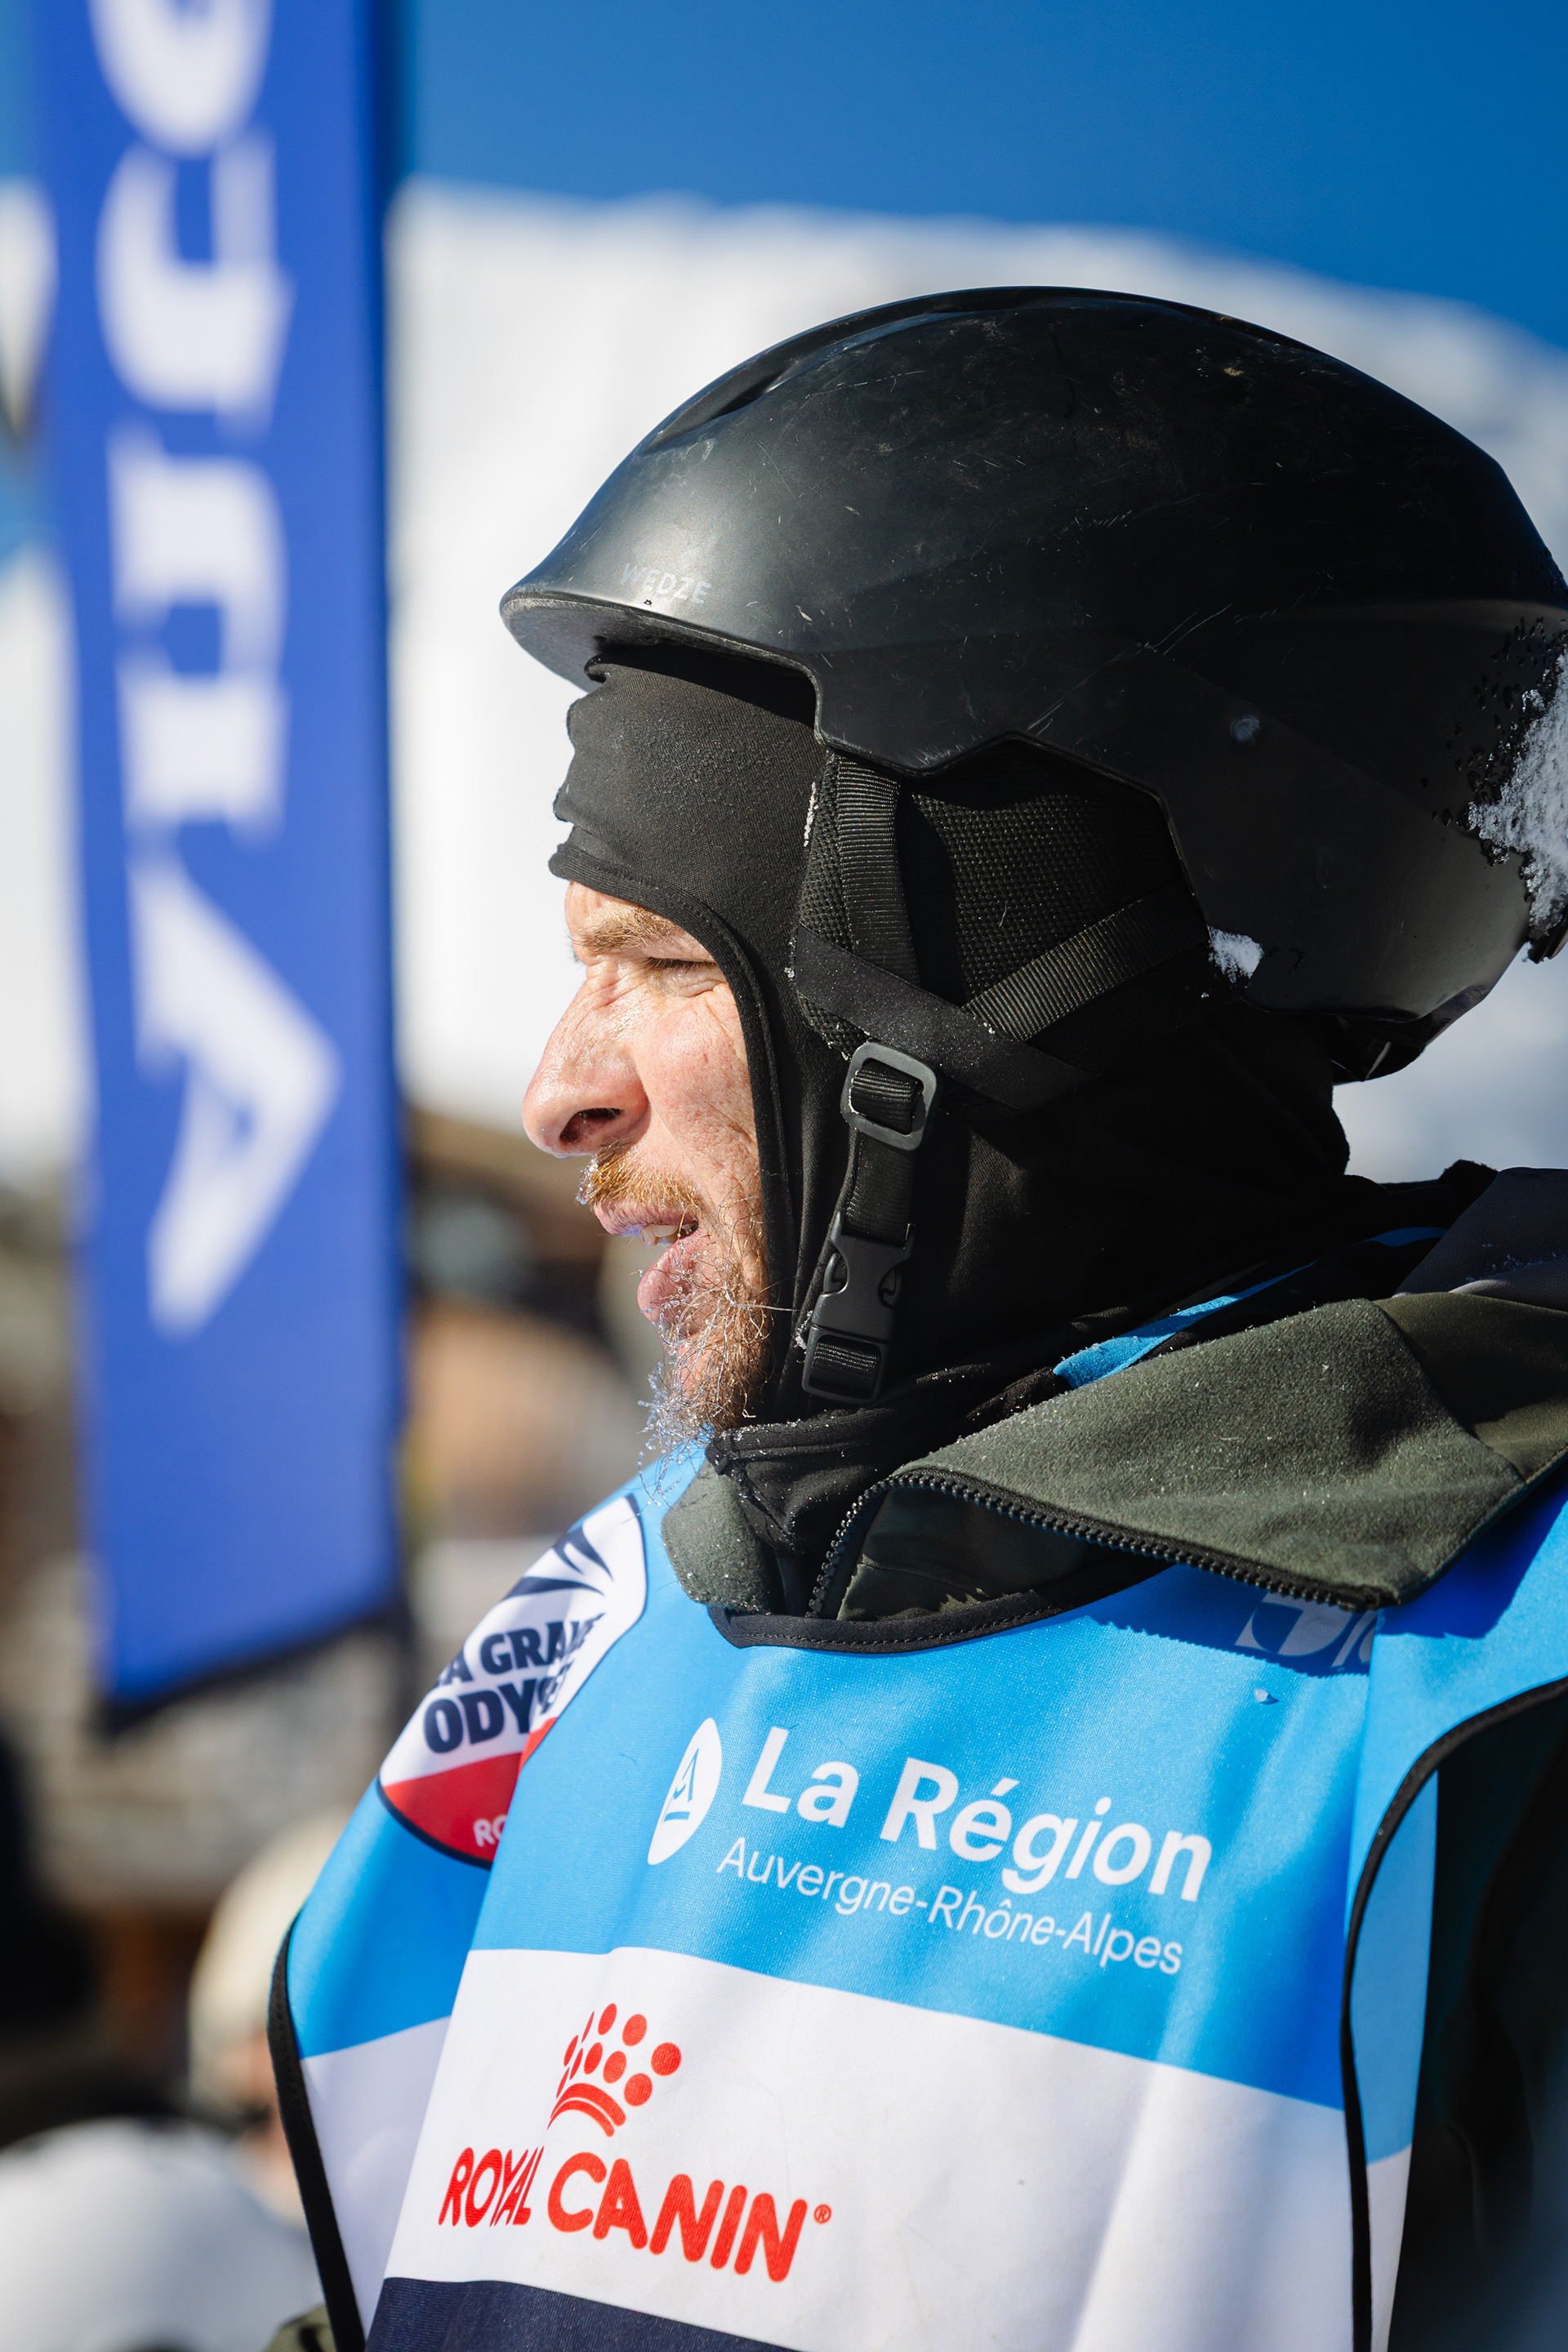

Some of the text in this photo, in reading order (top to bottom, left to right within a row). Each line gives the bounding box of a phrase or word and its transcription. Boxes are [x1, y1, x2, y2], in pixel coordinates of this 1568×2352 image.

[620, 563, 712, 605] WEDZE
[436, 1650, 474, 1686] A
[742, 1726, 1212, 1902] La Région
[716, 1836, 1183, 1975] Auvergne-Rhône-Alpes
[439, 2145, 544, 2228] ROYAL
